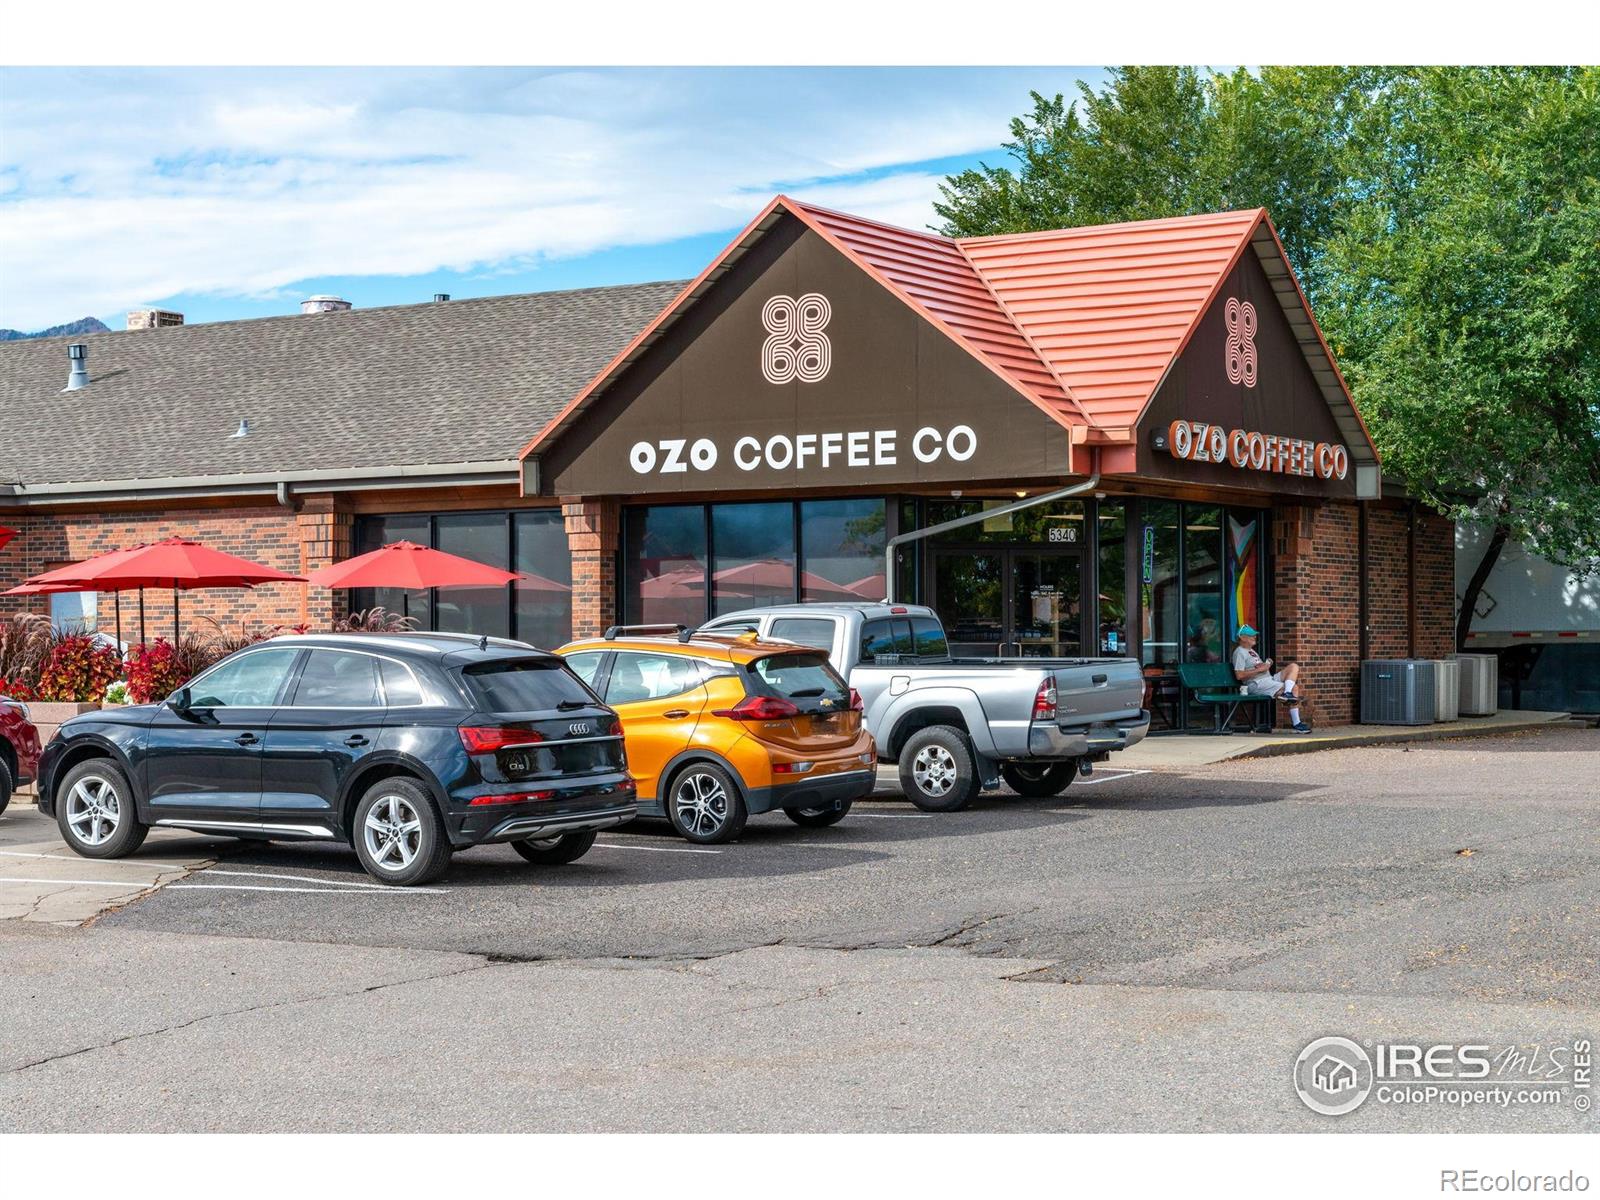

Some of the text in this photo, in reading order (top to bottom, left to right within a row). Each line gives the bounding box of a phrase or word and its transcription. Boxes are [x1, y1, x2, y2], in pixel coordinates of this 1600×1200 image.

[629, 424, 977, 474] OZO COFFEE CO
[1169, 420, 1348, 480] OZO COFFEE CO
[1050, 528, 1076, 542] 5340
